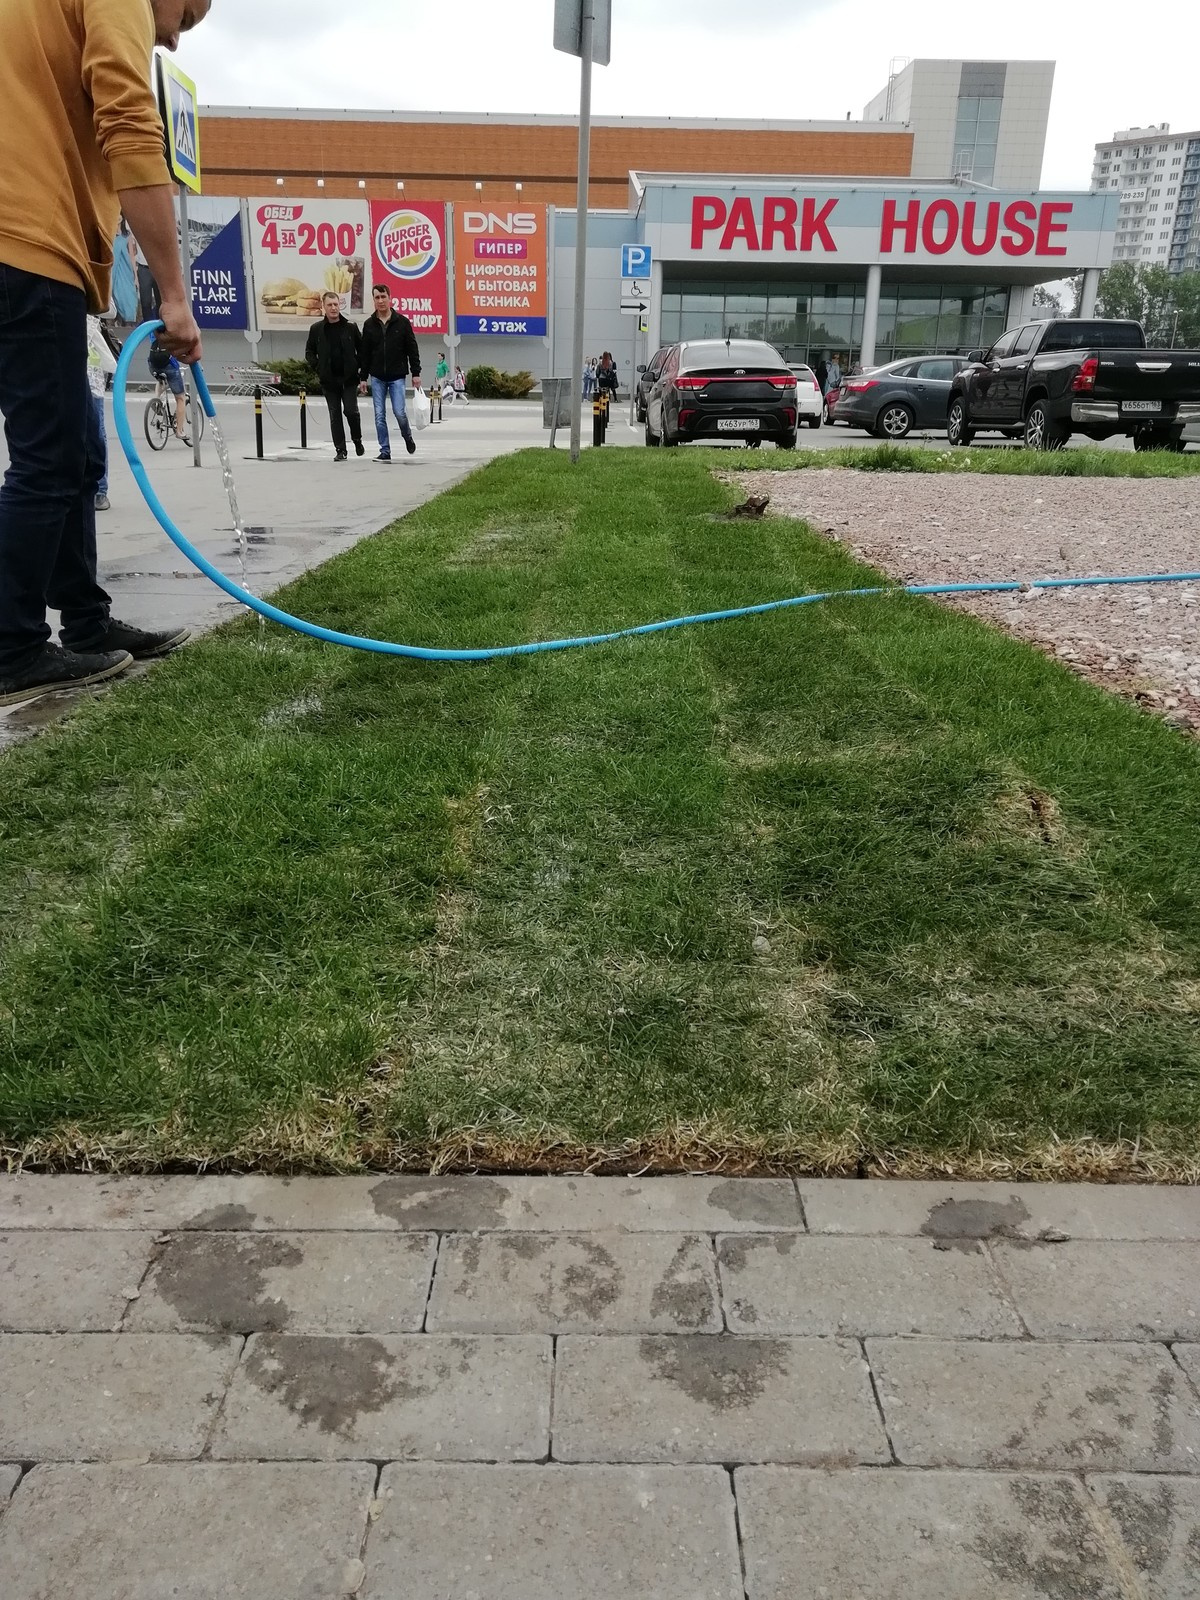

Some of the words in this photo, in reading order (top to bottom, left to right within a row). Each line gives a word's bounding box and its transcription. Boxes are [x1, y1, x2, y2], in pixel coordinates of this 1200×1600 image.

[264, 206, 294, 220] ОБЕД
[463, 211, 537, 234] DNS
[691, 196, 840, 252] PARK
[879, 198, 1074, 256] HOUSE
[261, 222, 281, 255] 4
[281, 232, 297, 245] ЗА
[384, 223, 430, 247] BURGER
[386, 235, 433, 264] KING
[479, 242, 523, 255] ГИПЕР
[193, 269, 232, 285] FINN
[465, 264, 537, 277] ЦИФРОВАЯ
[465, 279, 475, 291] И
[478, 280, 537, 292] БЫТОВАЯ
[191, 286, 237, 302] FLARE
[472, 295, 531, 308] ТЕХНИКА
[199, 305, 203, 315] 1
[204, 305, 232, 315] ЭТАЖ
[391, 297, 400, 311] 2
[401, 297, 432, 312] ЭТАЖ
[478, 318, 488, 332] 2
[491, 321, 527, 333] этаж
